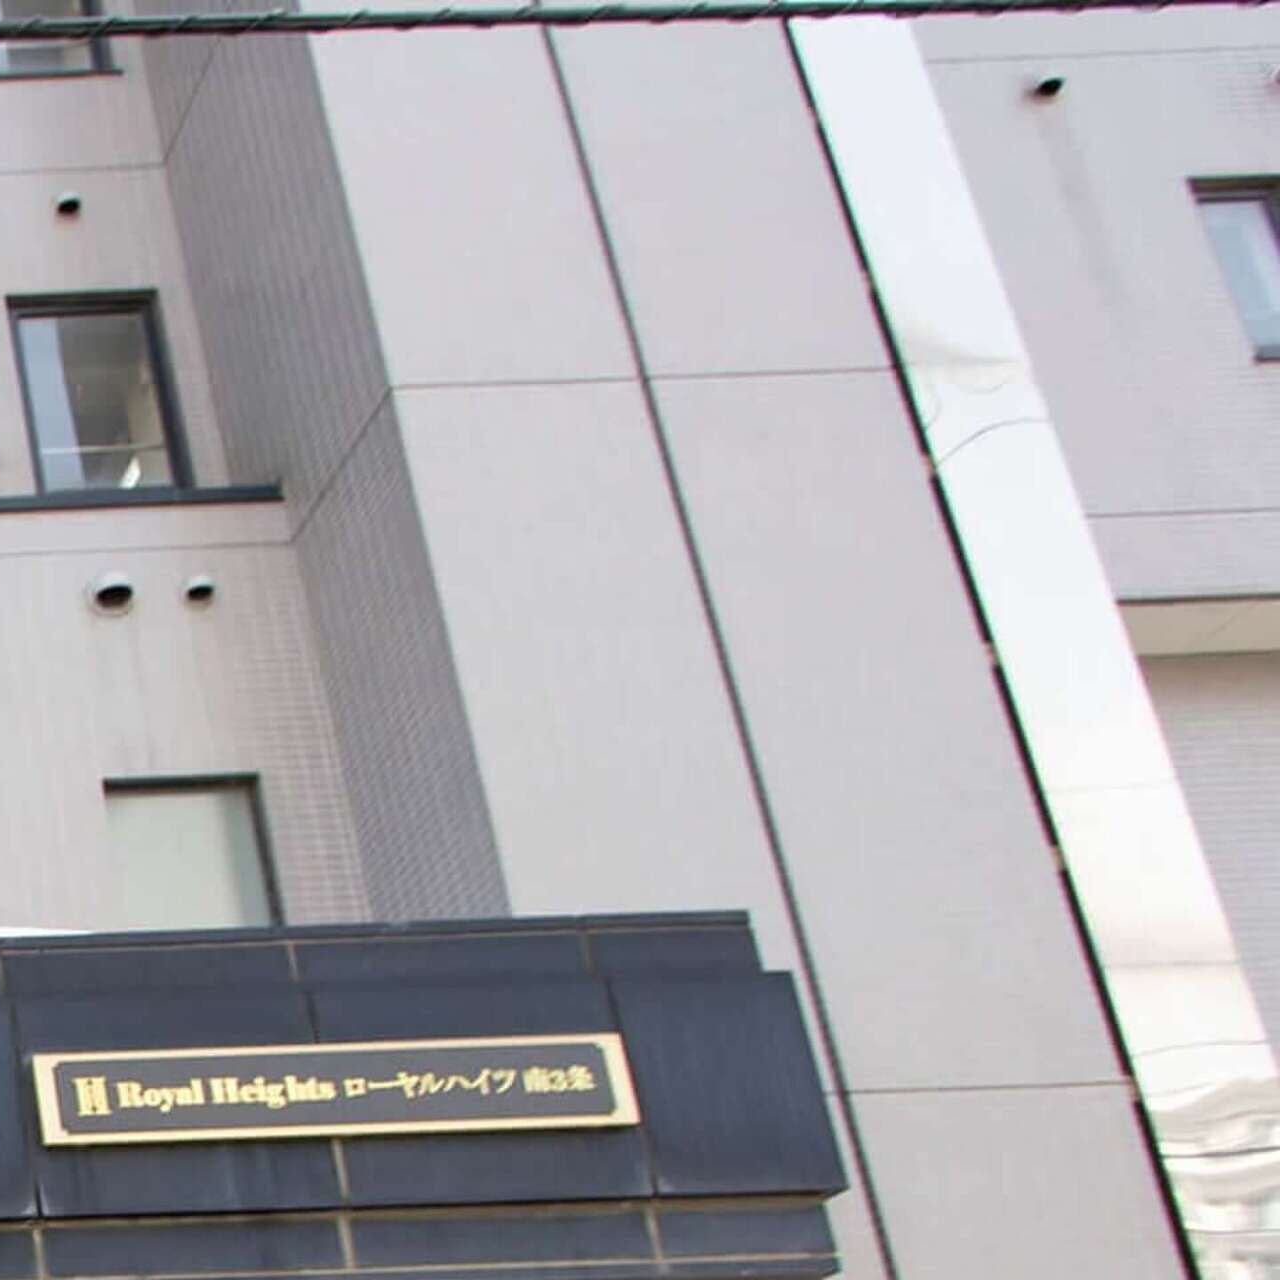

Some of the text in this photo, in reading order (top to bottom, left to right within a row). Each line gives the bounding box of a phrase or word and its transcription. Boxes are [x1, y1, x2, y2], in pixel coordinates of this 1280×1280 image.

[117, 1077, 206, 1112] Royal
[209, 1074, 337, 1109] Heights
[344, 1068, 517, 1098] ローヤルハイツ
[522, 1064, 597, 1093] 南3条
